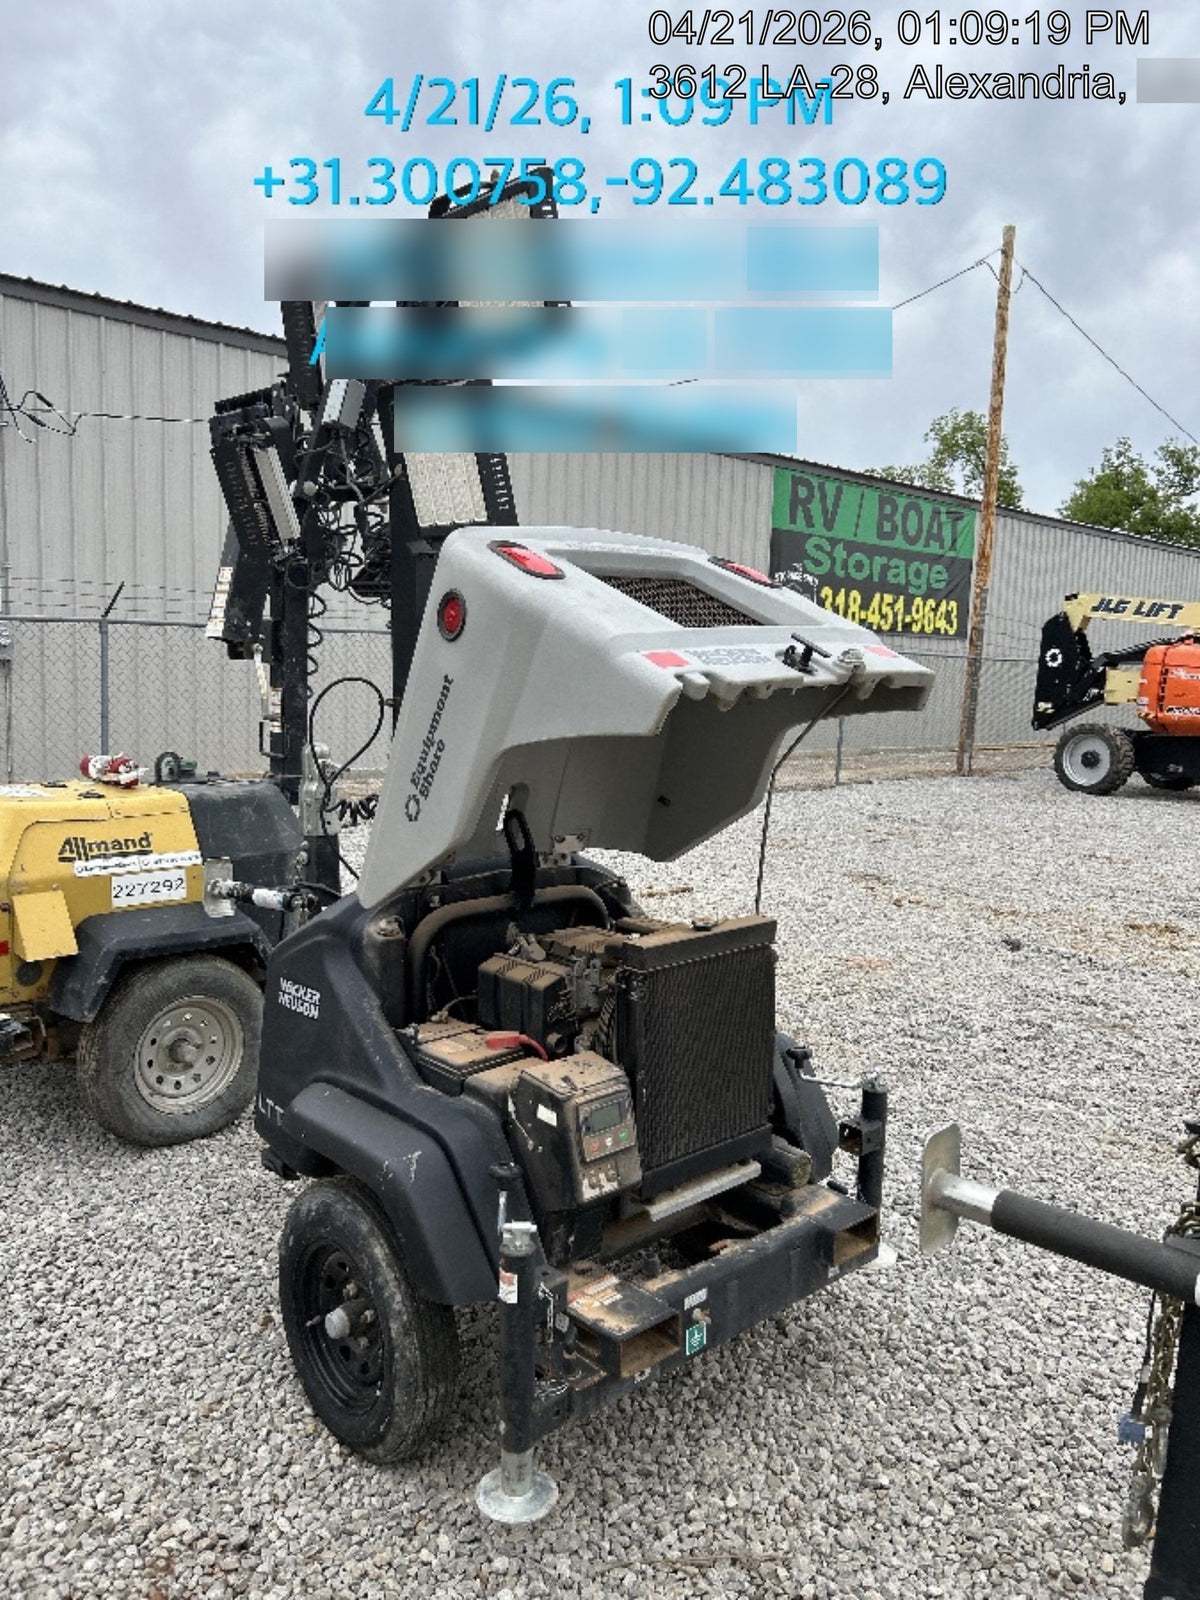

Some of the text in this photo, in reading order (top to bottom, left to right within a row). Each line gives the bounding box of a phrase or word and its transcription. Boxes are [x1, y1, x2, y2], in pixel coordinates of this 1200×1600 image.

[788, 474, 844, 532] RV
[876, 494, 966, 550] BOAT
[803, 536, 949, 595] Storage
[820, 586, 958, 635] 318-451-9643
[1091, 598, 1185, 619] JLG LIFT
[58, 832, 152, 862] Allmand
[113, 877, 185, 899] 227292
